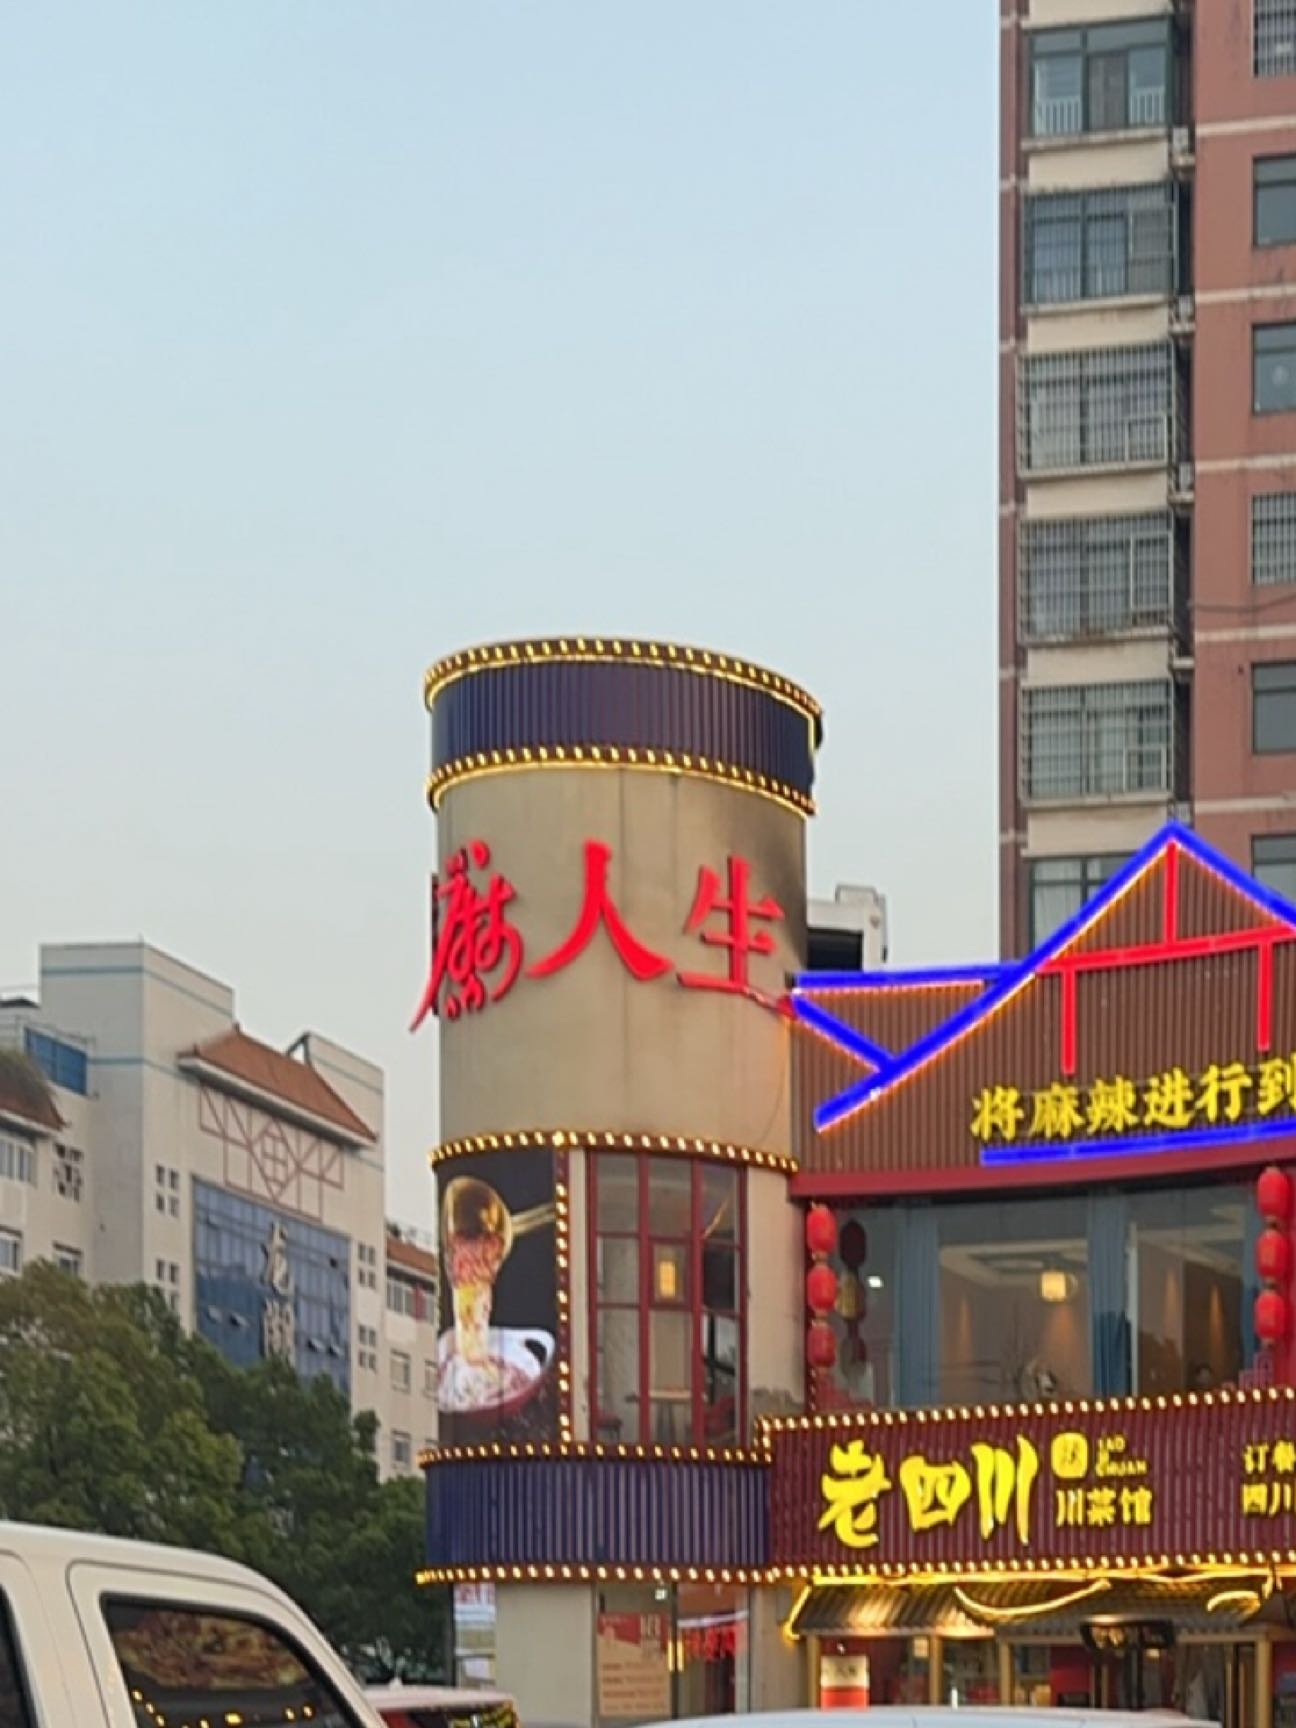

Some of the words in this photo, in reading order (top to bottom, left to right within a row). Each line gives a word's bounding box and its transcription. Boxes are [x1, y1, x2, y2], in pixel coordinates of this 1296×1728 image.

[818, 1434, 1038, 1547] 老四川
[1056, 1485, 1152, 1527] 川菜馆
